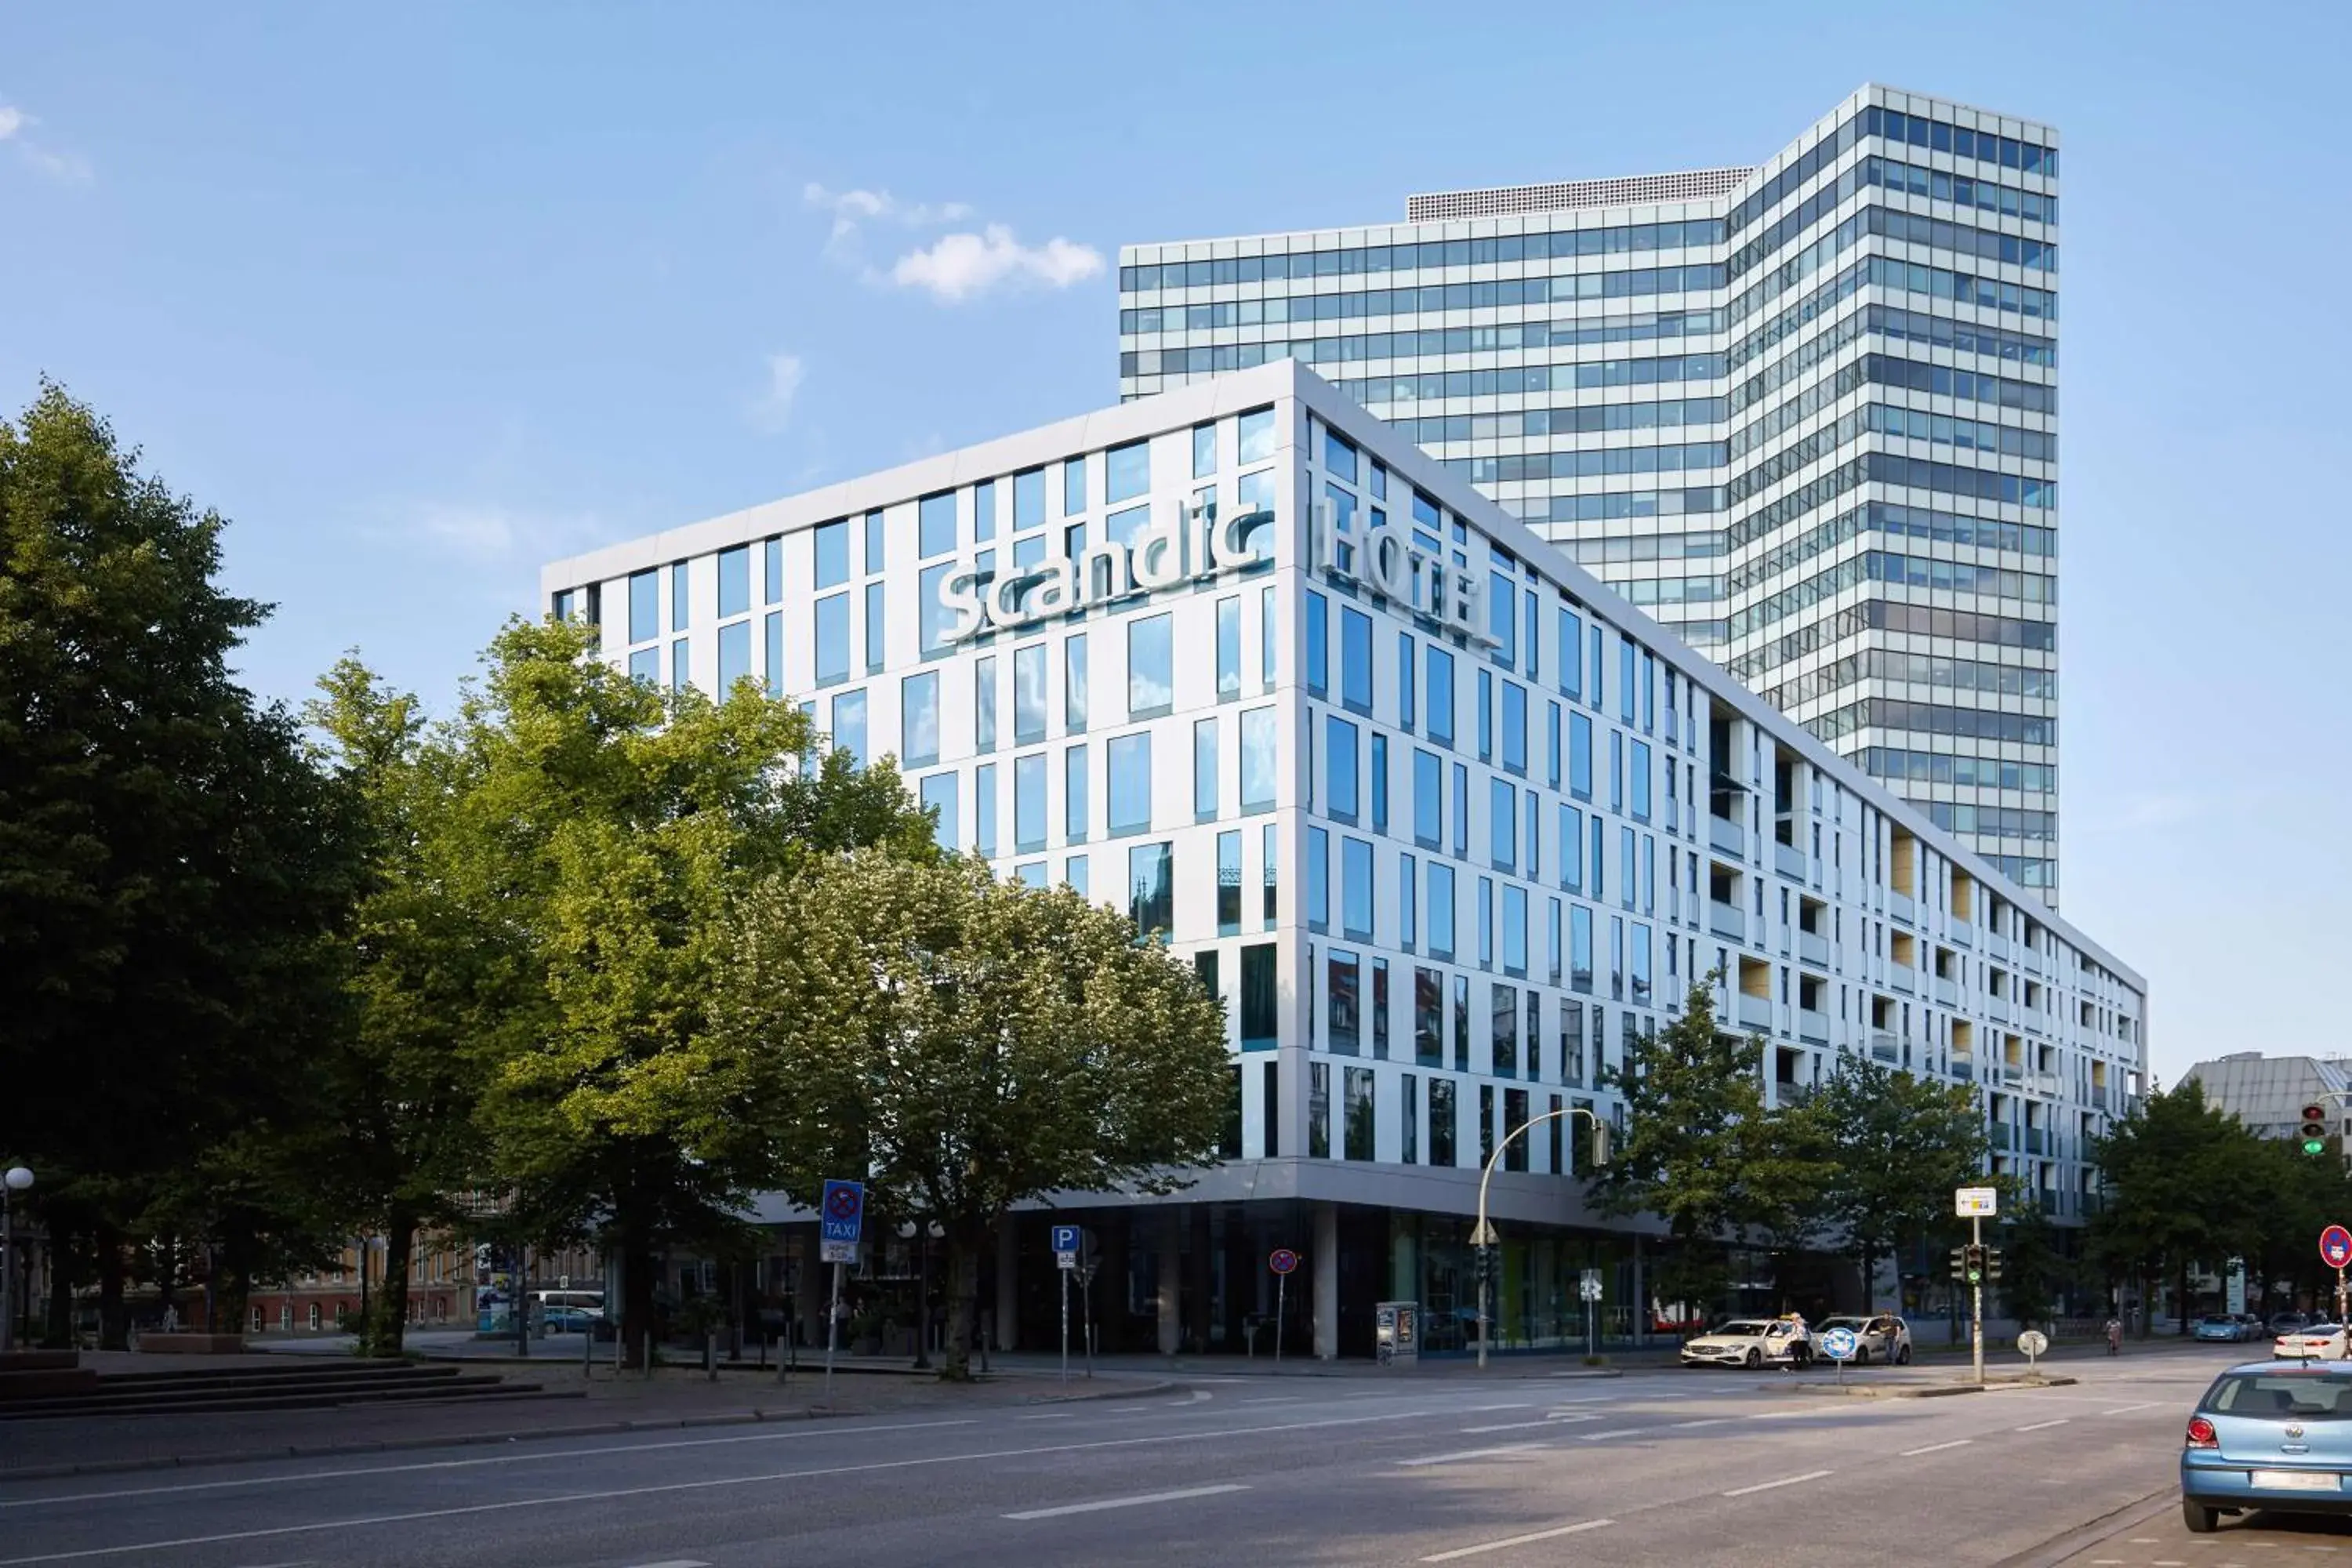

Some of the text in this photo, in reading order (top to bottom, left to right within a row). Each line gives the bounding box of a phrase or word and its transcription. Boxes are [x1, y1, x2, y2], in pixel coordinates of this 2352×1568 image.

[938, 490, 1261, 644] Scandic
[1320, 495, 1504, 650] HOTEL
[826, 1221, 857, 1238] TAXI
[1059, 1229, 1073, 1248] P
